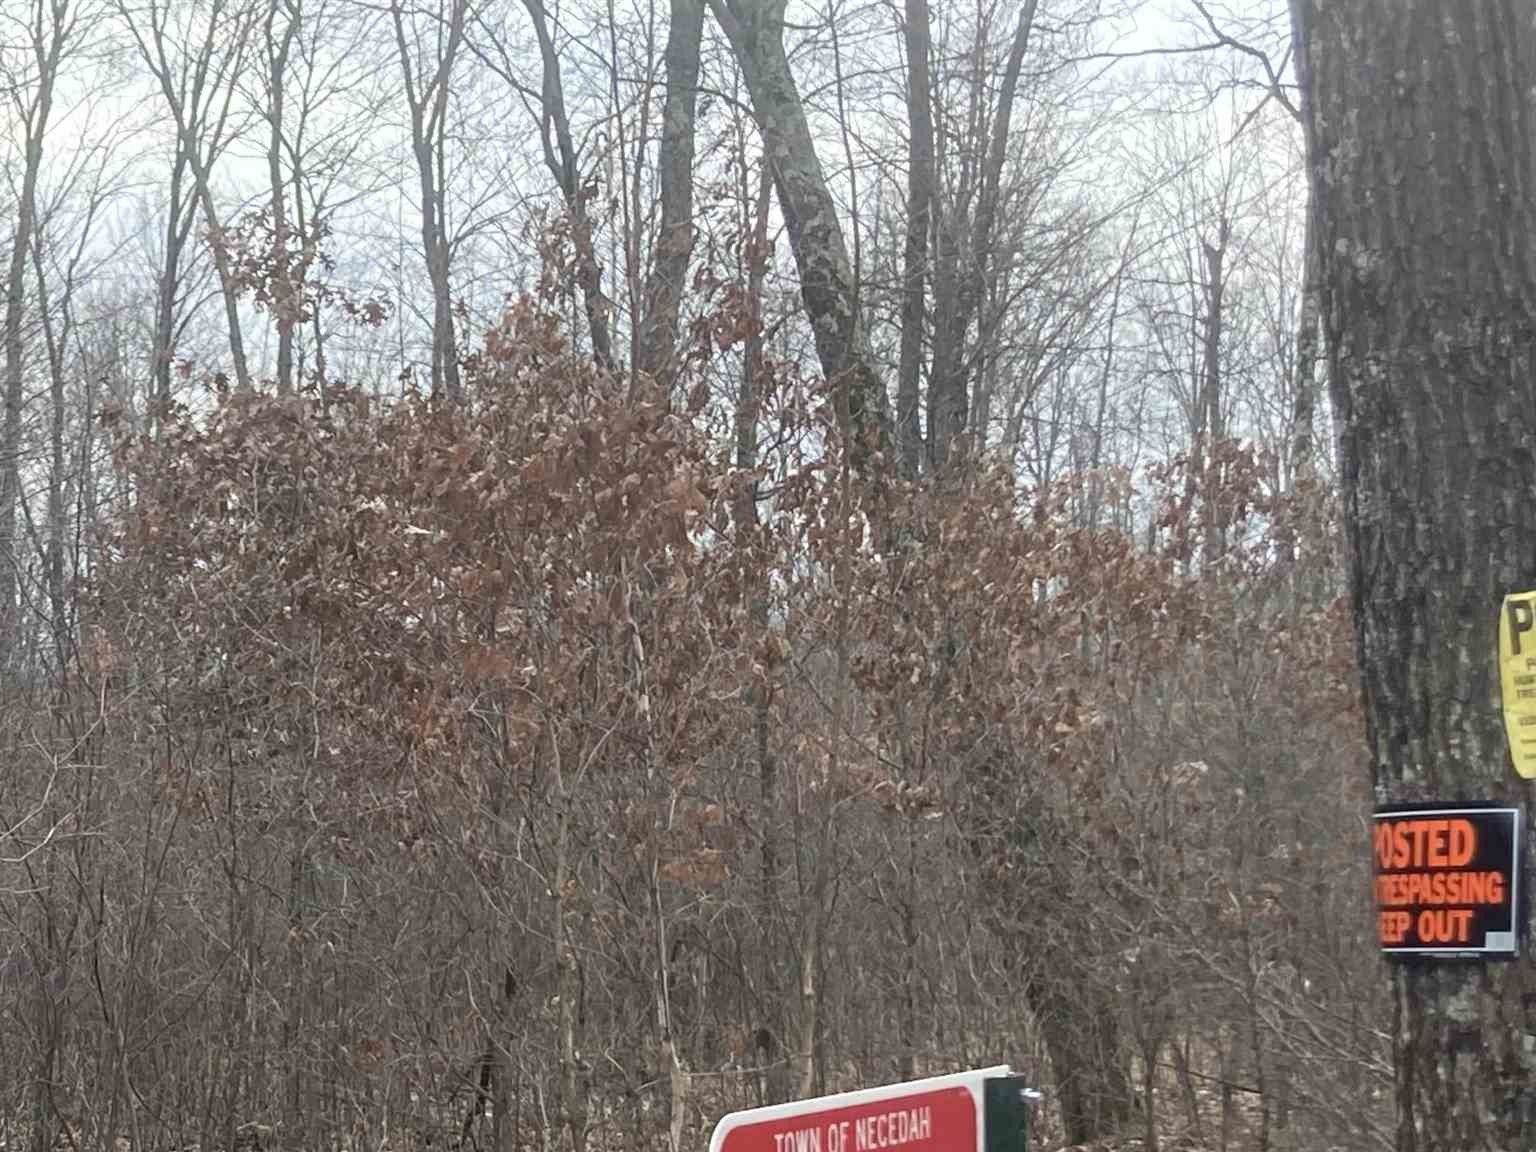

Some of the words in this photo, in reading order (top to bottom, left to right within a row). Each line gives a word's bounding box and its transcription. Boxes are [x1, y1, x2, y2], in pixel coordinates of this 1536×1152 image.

[1378, 911, 1410, 943] EEP
[1418, 909, 1473, 943] OUT
[855, 1106, 931, 1152] NECEDAH
